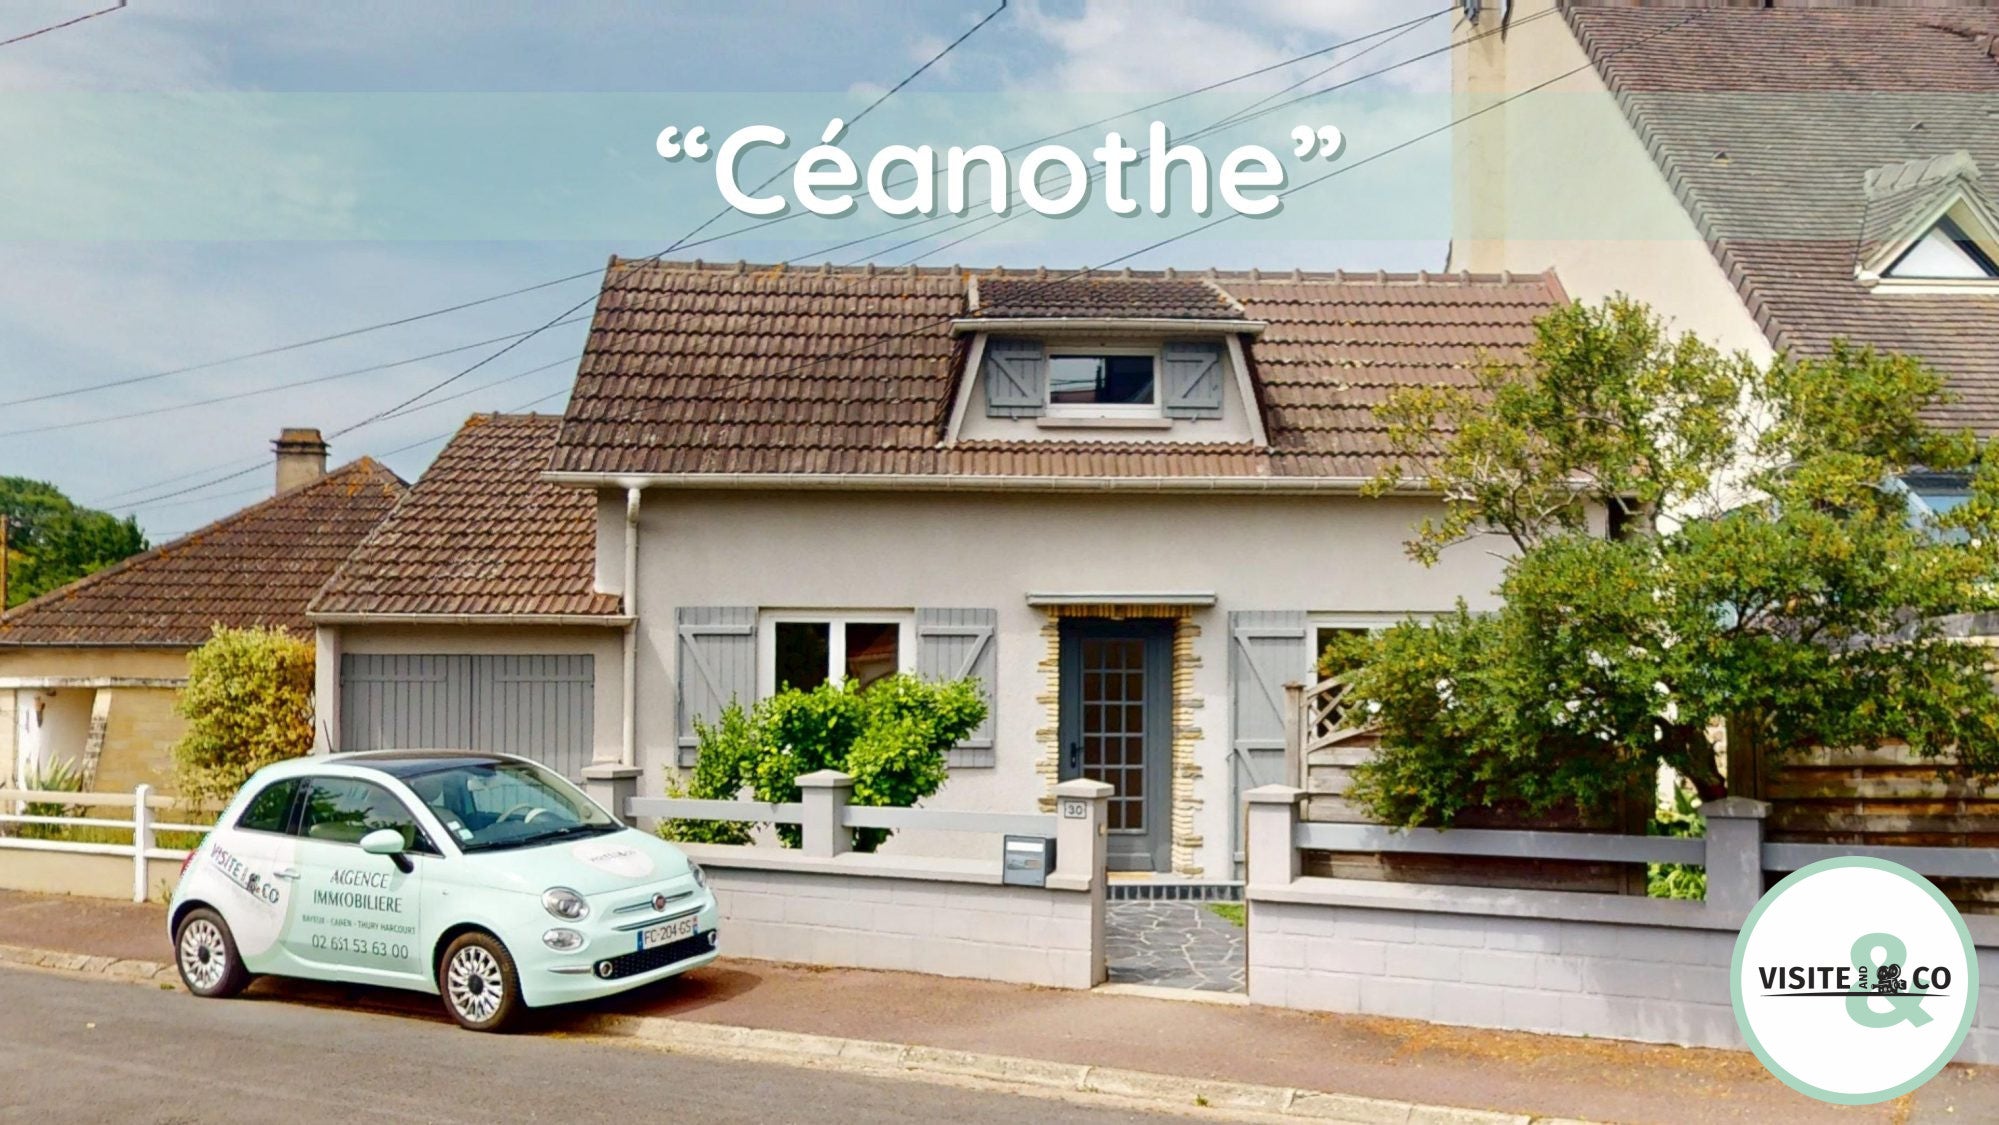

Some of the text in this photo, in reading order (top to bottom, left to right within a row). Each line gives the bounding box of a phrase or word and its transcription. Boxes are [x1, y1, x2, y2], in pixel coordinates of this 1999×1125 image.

[1068, 804, 1083, 815] 30
[262, 883, 280, 904] CO
[358, 920, 379, 930] THURY
[380, 924, 416, 935] HARCOURT
[312, 934, 327, 949] 02
[353, 938, 368, 954] 53
[372, 941, 387, 956] 63
[392, 944, 409, 959] 00
